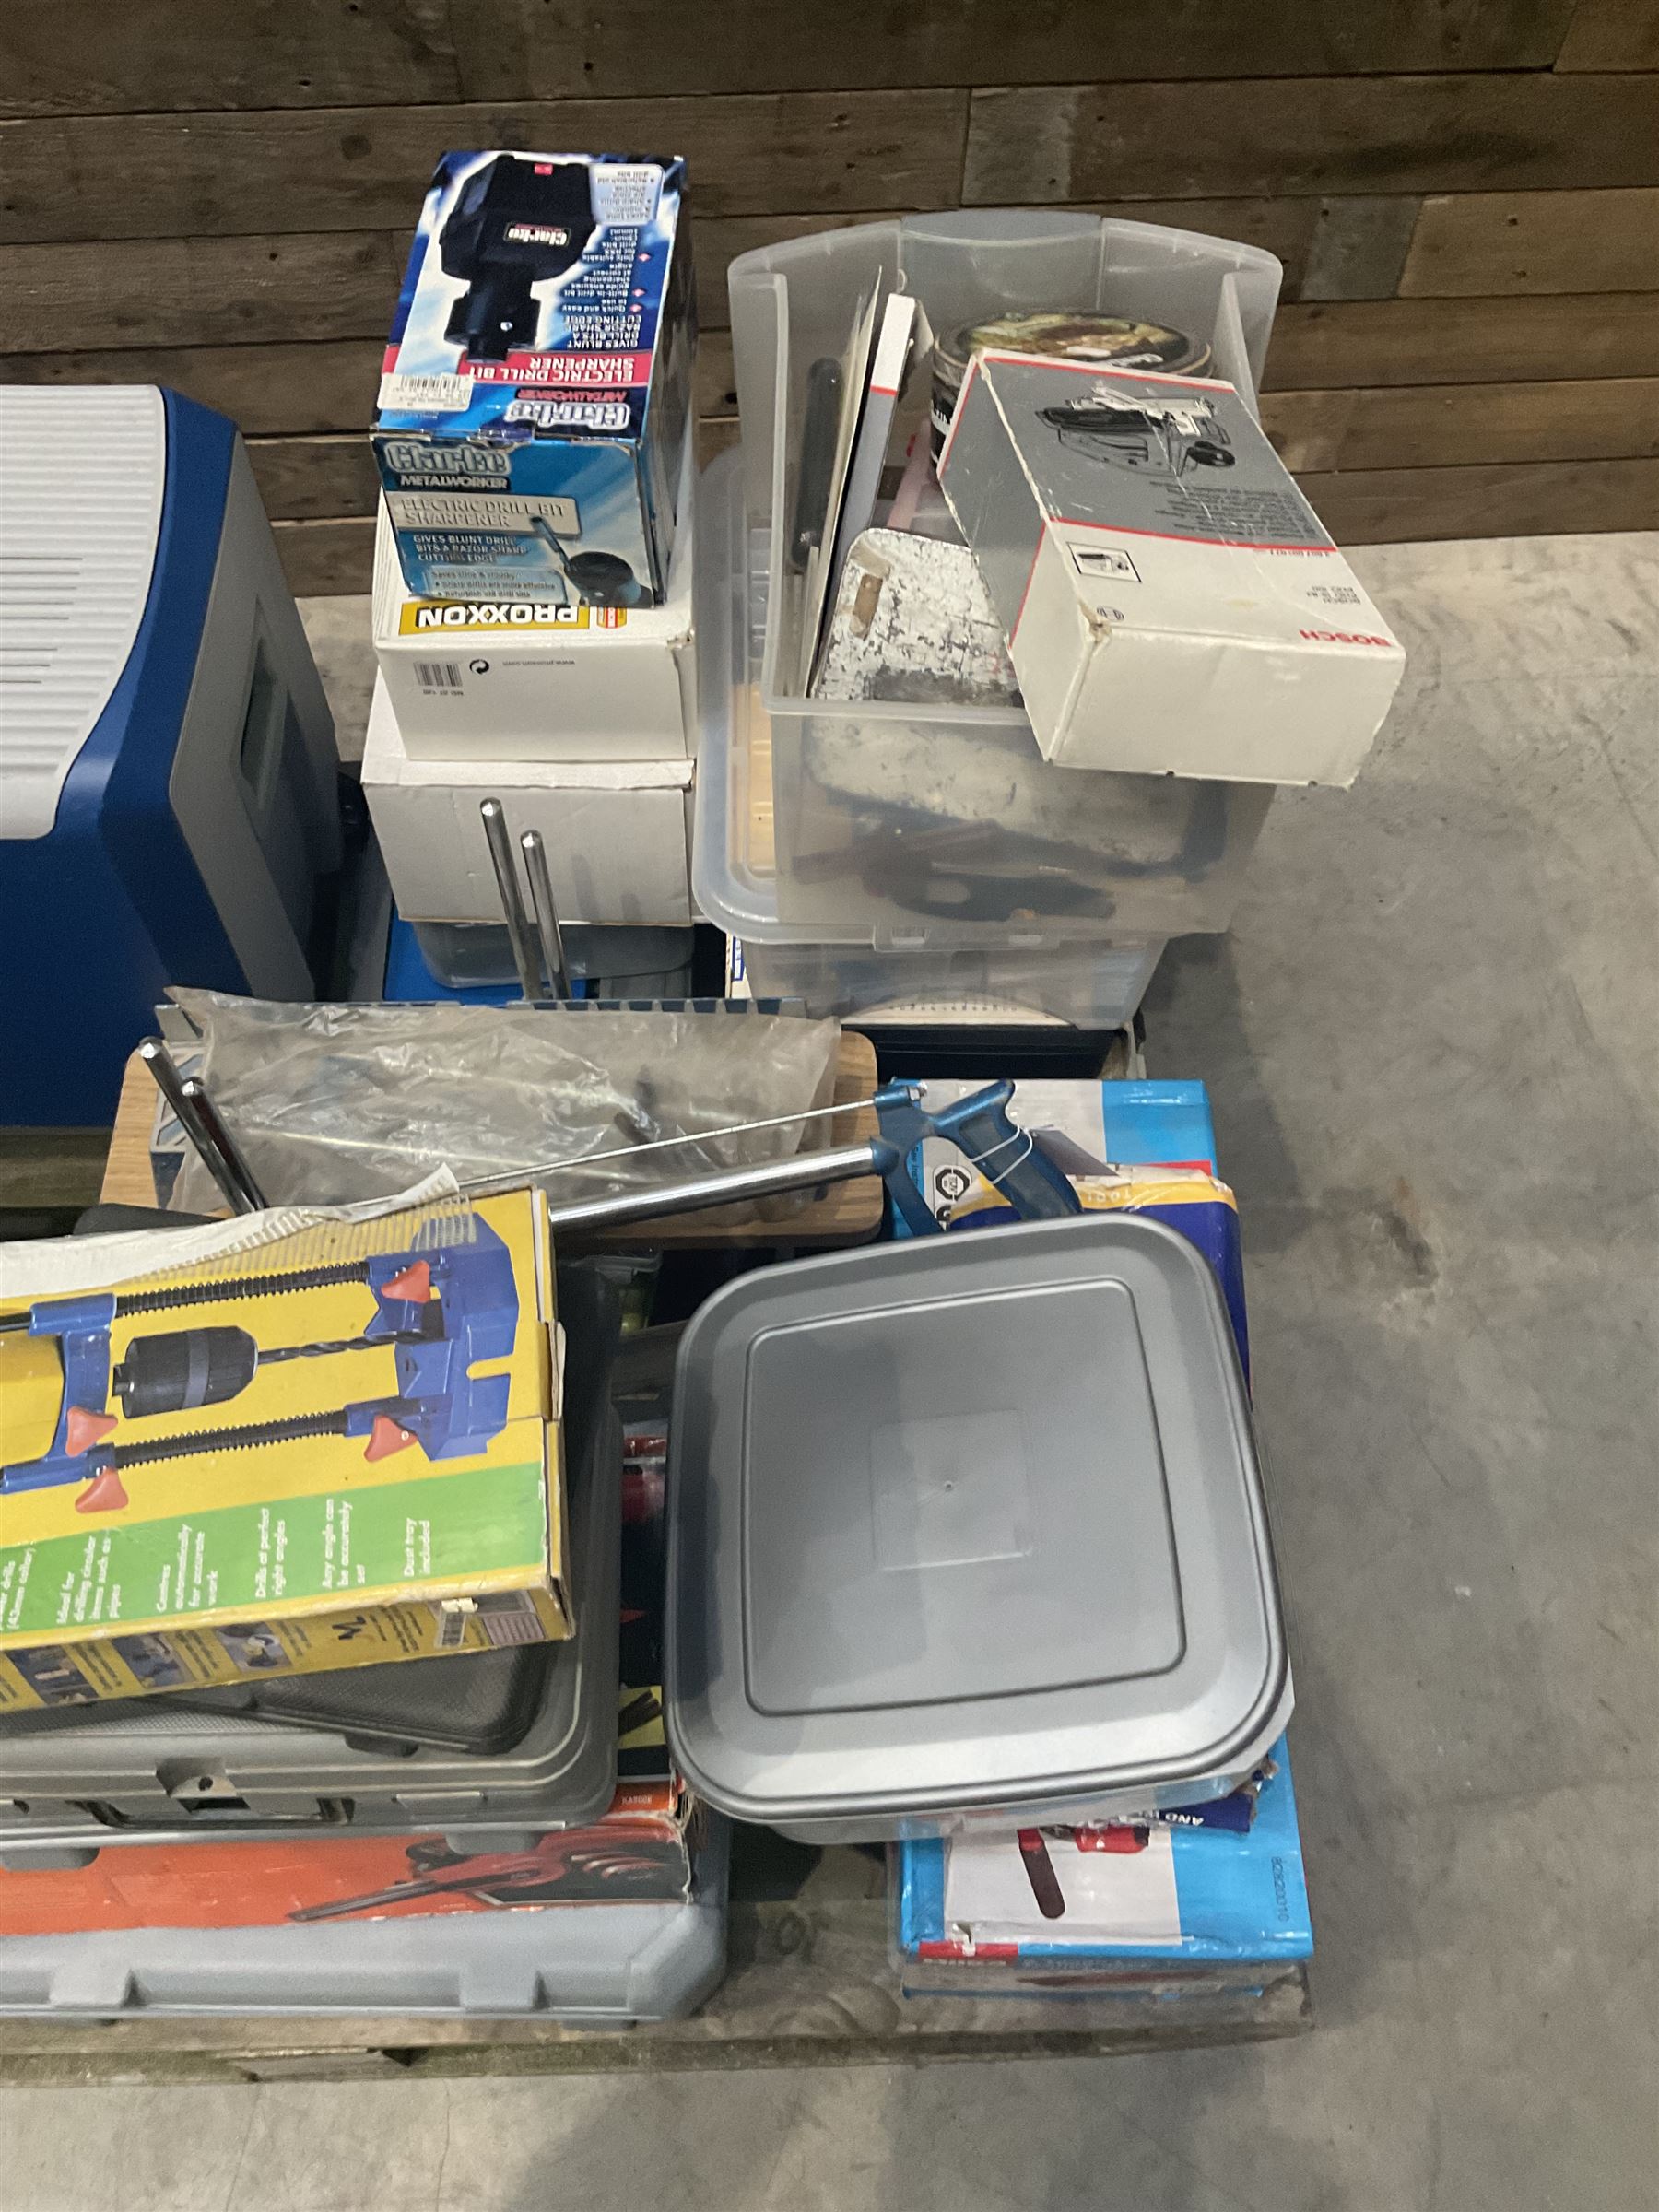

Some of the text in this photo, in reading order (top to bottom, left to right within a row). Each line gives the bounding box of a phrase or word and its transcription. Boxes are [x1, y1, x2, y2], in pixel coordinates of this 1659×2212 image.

[508, 228, 568, 246] Clarke
[561, 304, 626, 313] Quick and easy
[601, 298, 617, 306] use
[563, 314, 642, 324] CUTTING EDGE
[604, 323, 641, 332] RAZOR
[566, 338, 639, 348] GIVES BLUNT
[582, 330, 607, 340] BITS
[608, 330, 640, 340] DRILL
[530, 357, 636, 370] SHARPENER
[468, 366, 634, 382] ELECTRIC DRILL BIT
[517, 388, 628, 402] METALWORKER
[504, 400, 630, 429] Clarke
[385, 442, 511, 474] Clarke
[400, 474, 508, 488] METALWORKER
[401, 498, 565, 517] ELECTRIC DRILL BIT
[406, 512, 511, 527] SHARPENER
[413, 535, 516, 546] GIVES BLUNT DRILL
[416, 544, 441, 553] BITS
[451, 544, 488, 554] RAZOR
[418, 553, 465, 563] CUTTING
[418, 604, 579, 629] PROXXON
[1300, 629, 1393, 647] BOSCH
[254, 1507, 271, 1598] Drills at perfect
[322, 1498, 335, 1589] Any angle can
[337, 1500, 353, 1587] be accurately
[404, 1517, 418, 1578] Dust tray
[418, 1520, 431, 1576] included
[271, 1519, 288, 1596] right angles
[174, 1523, 193, 1611] automatically
[188, 1531, 206, 1608] for accurate
[356, 1563, 366, 1584] set
[61, 1571, 75, 1591] for
[72, 1535, 96, 1623] drilling circular
[89, 1536, 112, 1620] items such as
[206, 1570, 219, 1606] work
[106, 1583, 122, 1619] pipes
[1164, 1812, 1205, 1826] AND
